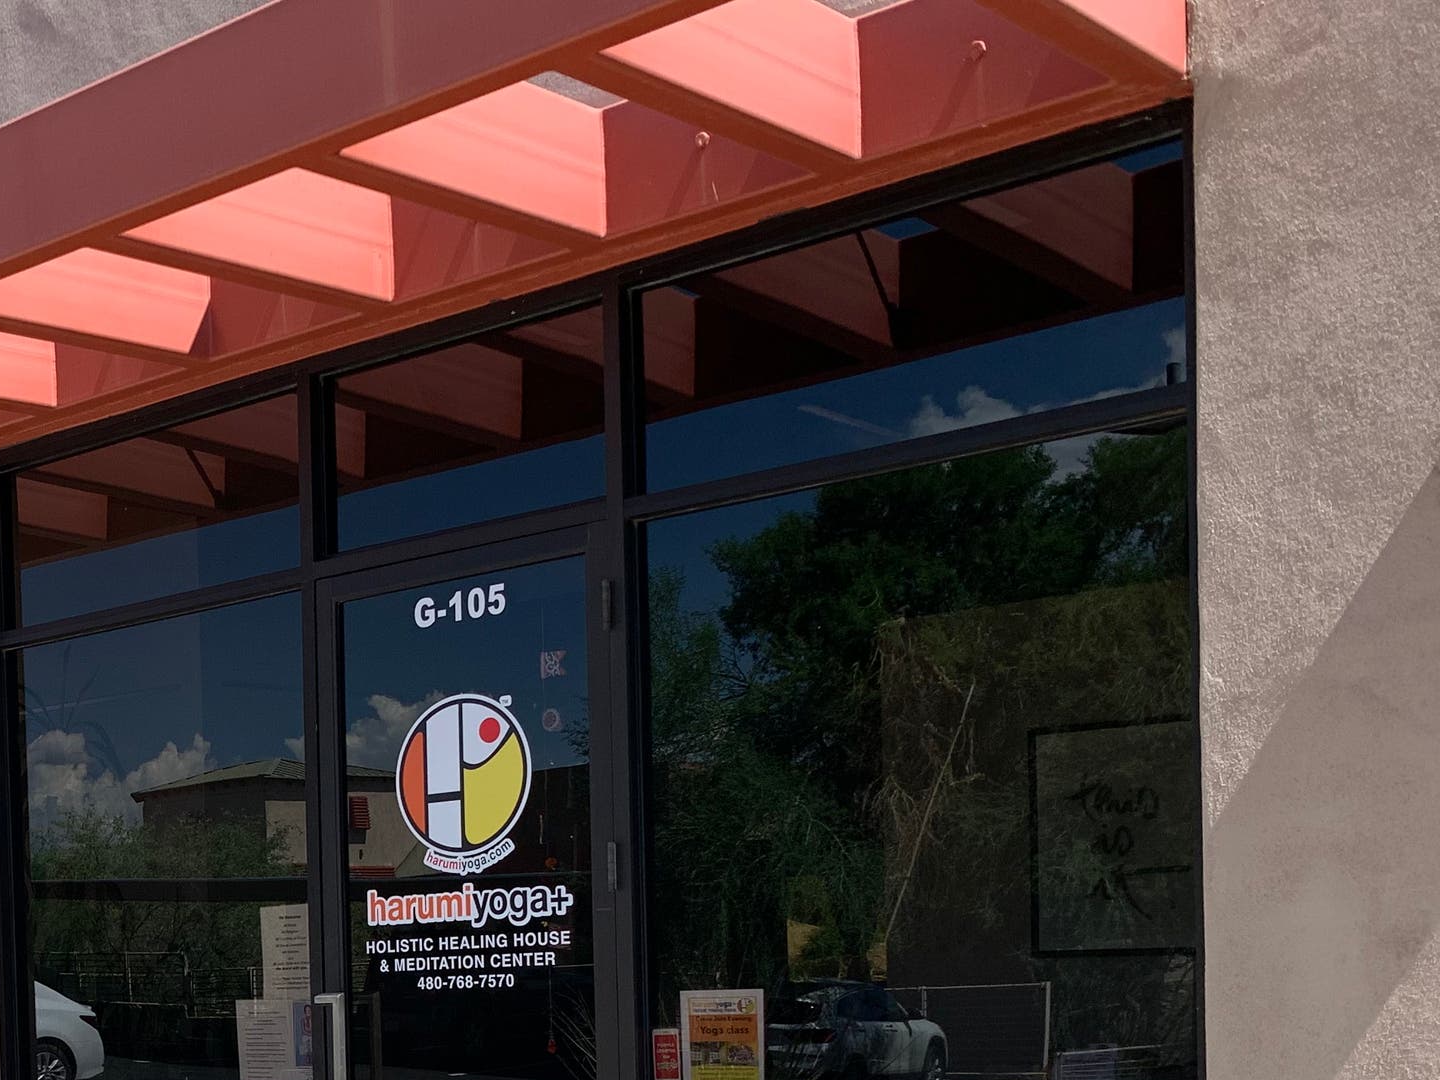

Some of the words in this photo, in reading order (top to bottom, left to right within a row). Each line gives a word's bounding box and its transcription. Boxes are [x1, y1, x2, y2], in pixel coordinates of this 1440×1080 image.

[414, 583, 506, 628] G-105
[426, 842, 512, 872] harumiyoga.com
[368, 884, 572, 926] harumiyoga+
[366, 938, 434, 954] HOLISTIC
[439, 934, 508, 950] HEALING
[513, 931, 571, 946] HOUSE
[379, 959, 390, 972] &
[394, 955, 485, 972] MEDITATION
[490, 952, 556, 967] CENTER
[417, 973, 515, 990] 480-768-7570
[701, 1026, 723, 1036] Yoga
[727, 1025, 750, 1035] class
